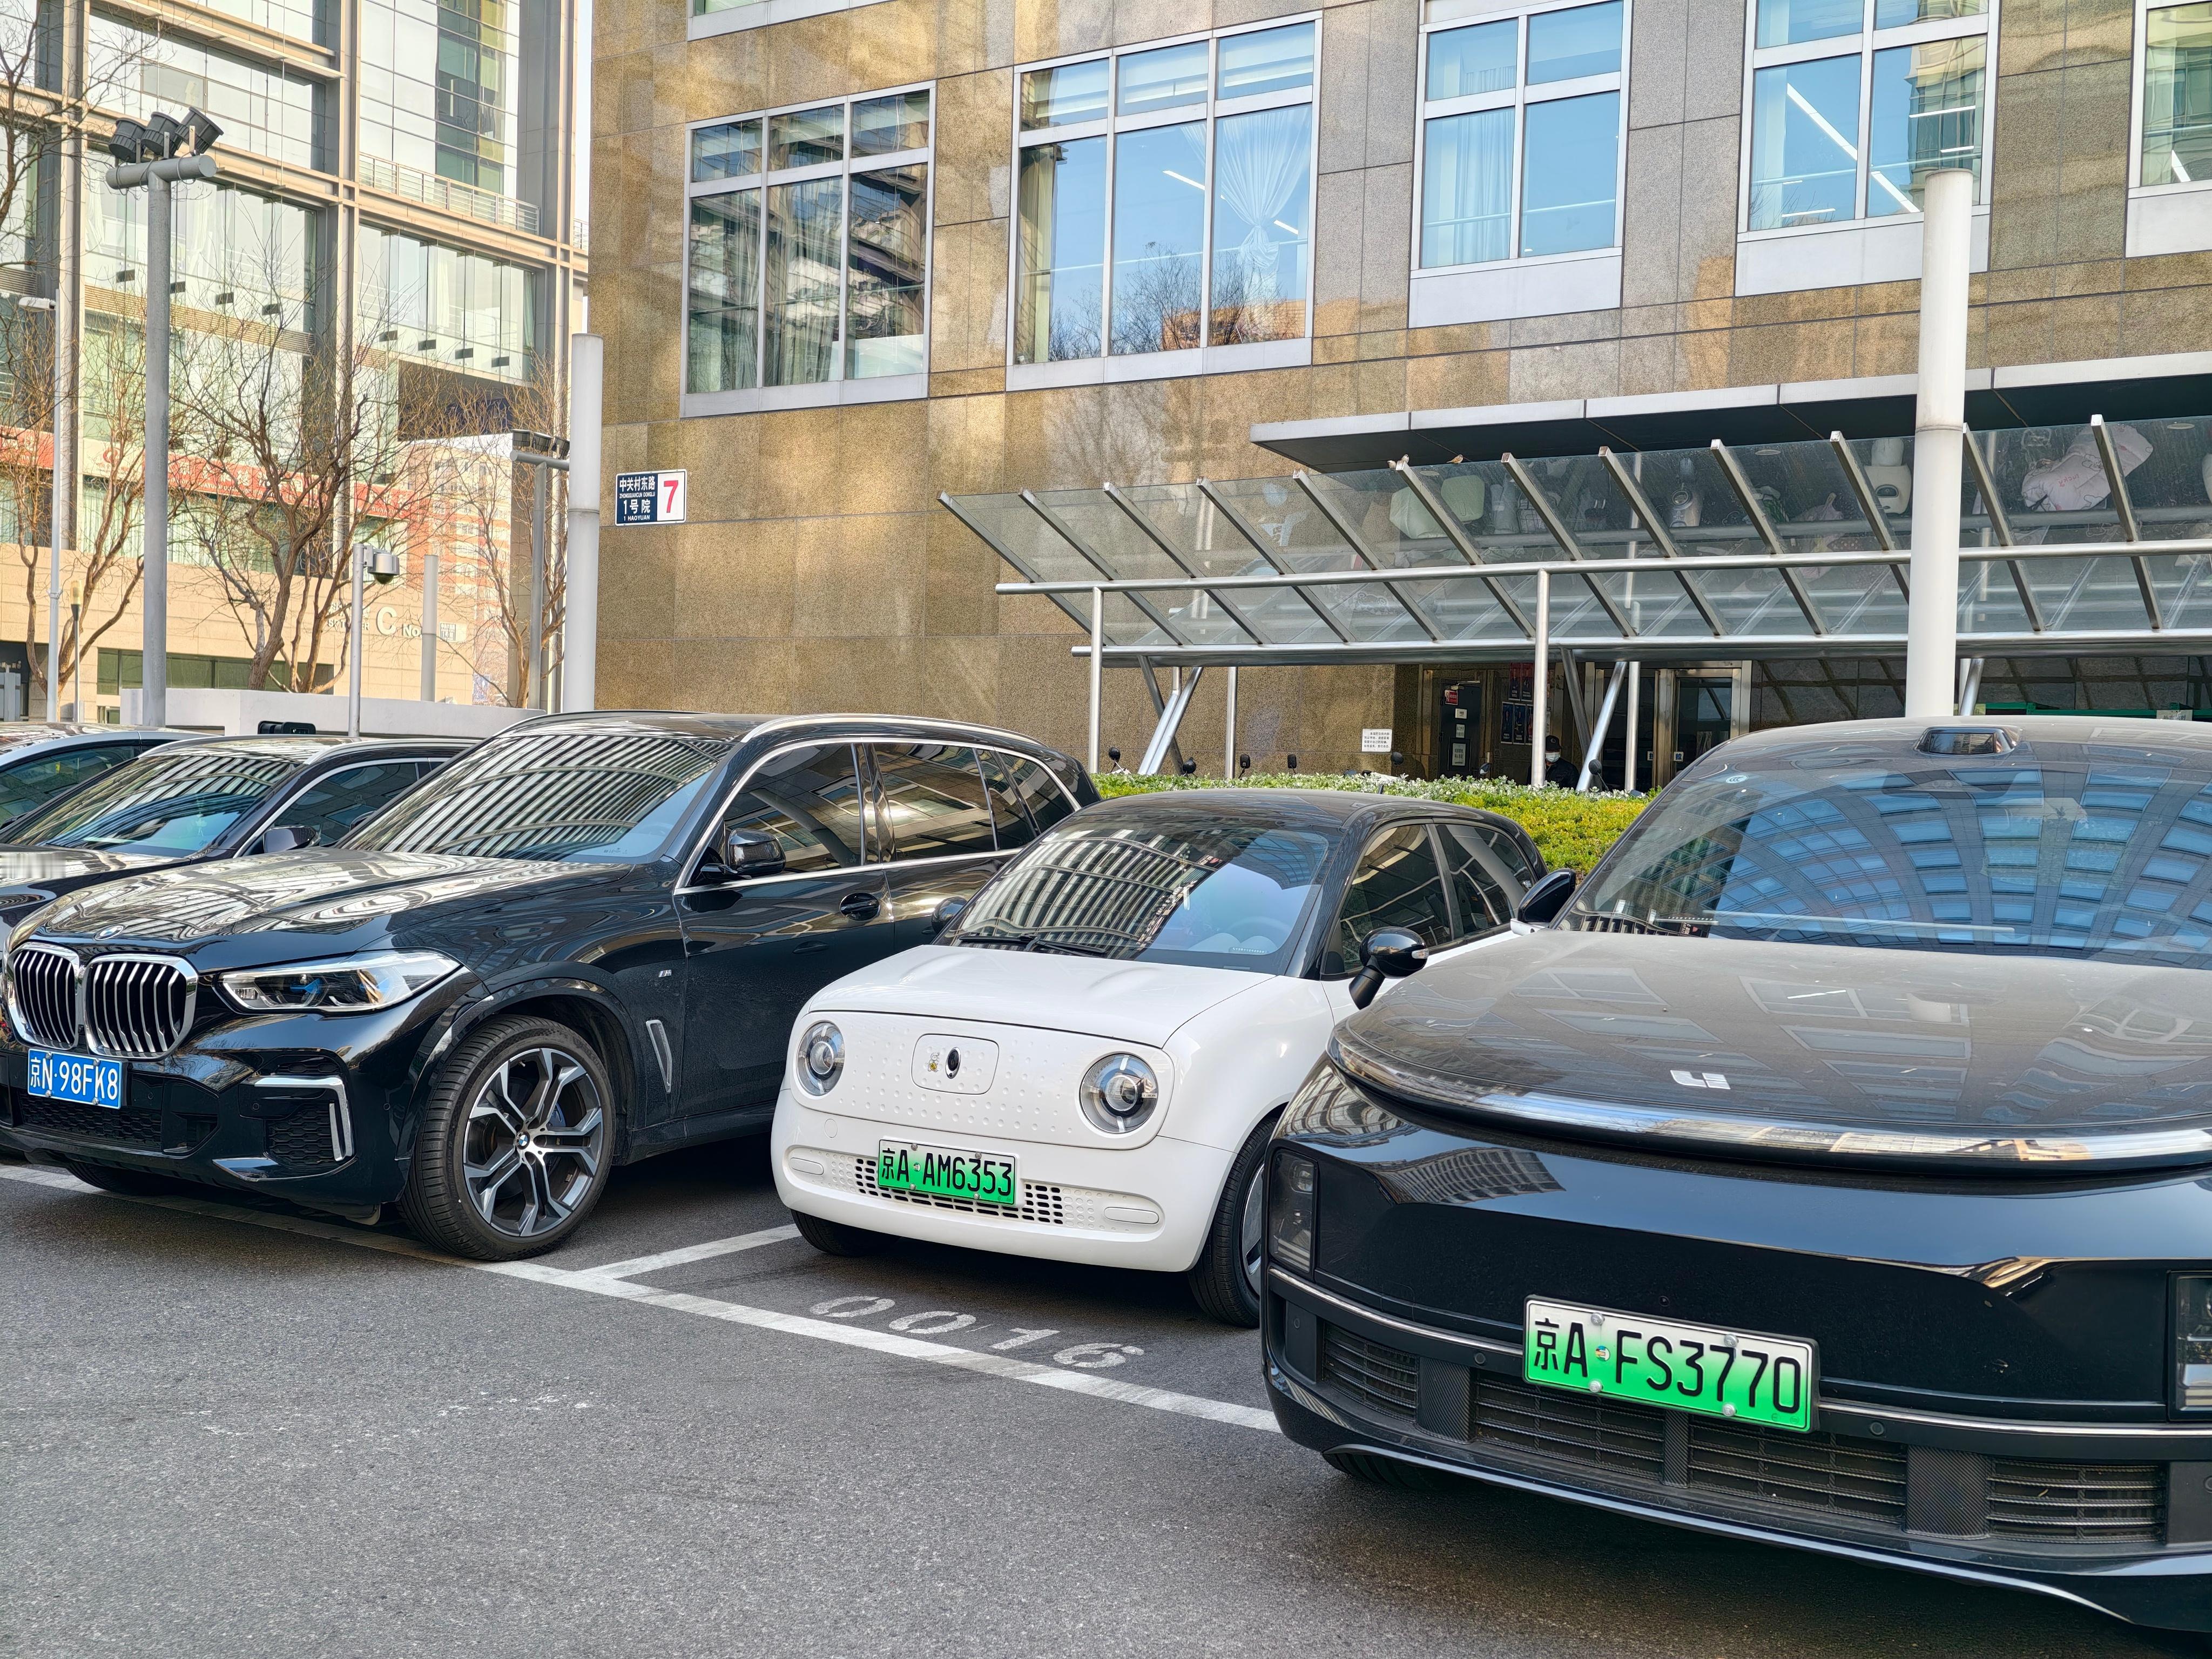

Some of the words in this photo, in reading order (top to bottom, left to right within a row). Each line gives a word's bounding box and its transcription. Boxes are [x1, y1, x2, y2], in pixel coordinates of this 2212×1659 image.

[619, 475, 655, 492] 中关村东路
[664, 480, 678, 513] 7
[623, 499, 651, 515] 1号院
[376, 606, 397, 636] C
[810, 1295, 1145, 1368] 0016
